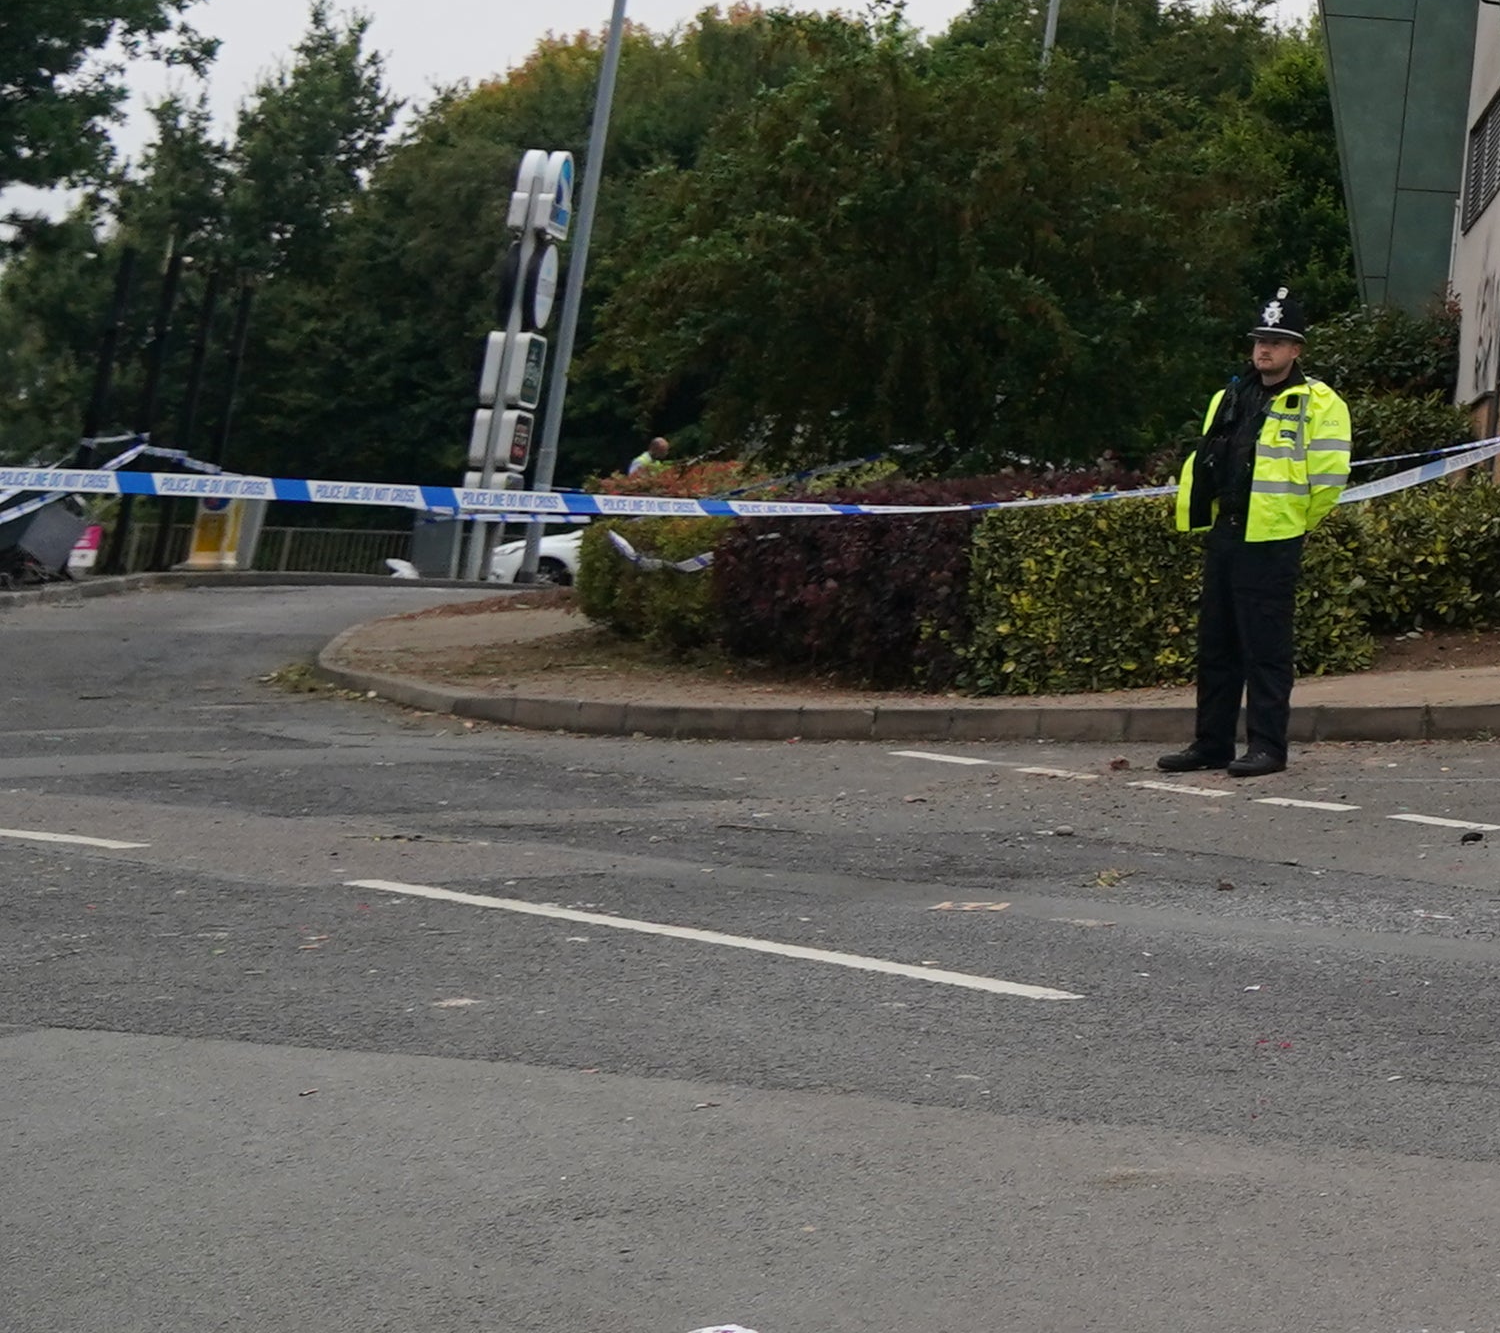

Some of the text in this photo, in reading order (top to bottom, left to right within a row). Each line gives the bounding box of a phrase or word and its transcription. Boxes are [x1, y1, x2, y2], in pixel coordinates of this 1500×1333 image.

[28, 472, 48, 487] LINE
[82, 473, 110, 489] CROSS
[161, 476, 189, 492] POLICE
[190, 478, 208, 493] LINE
[241, 481, 267, 495] CROSS
[316, 484, 343, 499] POLICE
[344, 486, 360, 500] LINE
[391, 488, 416, 502] CROSS
[462, 491, 489, 505] POLICE
[489, 493, 505, 506] LINE
[534, 495, 558, 508] CROSS
[603, 498, 627, 511] POLICE
[672, 501, 696, 513] CROSS
